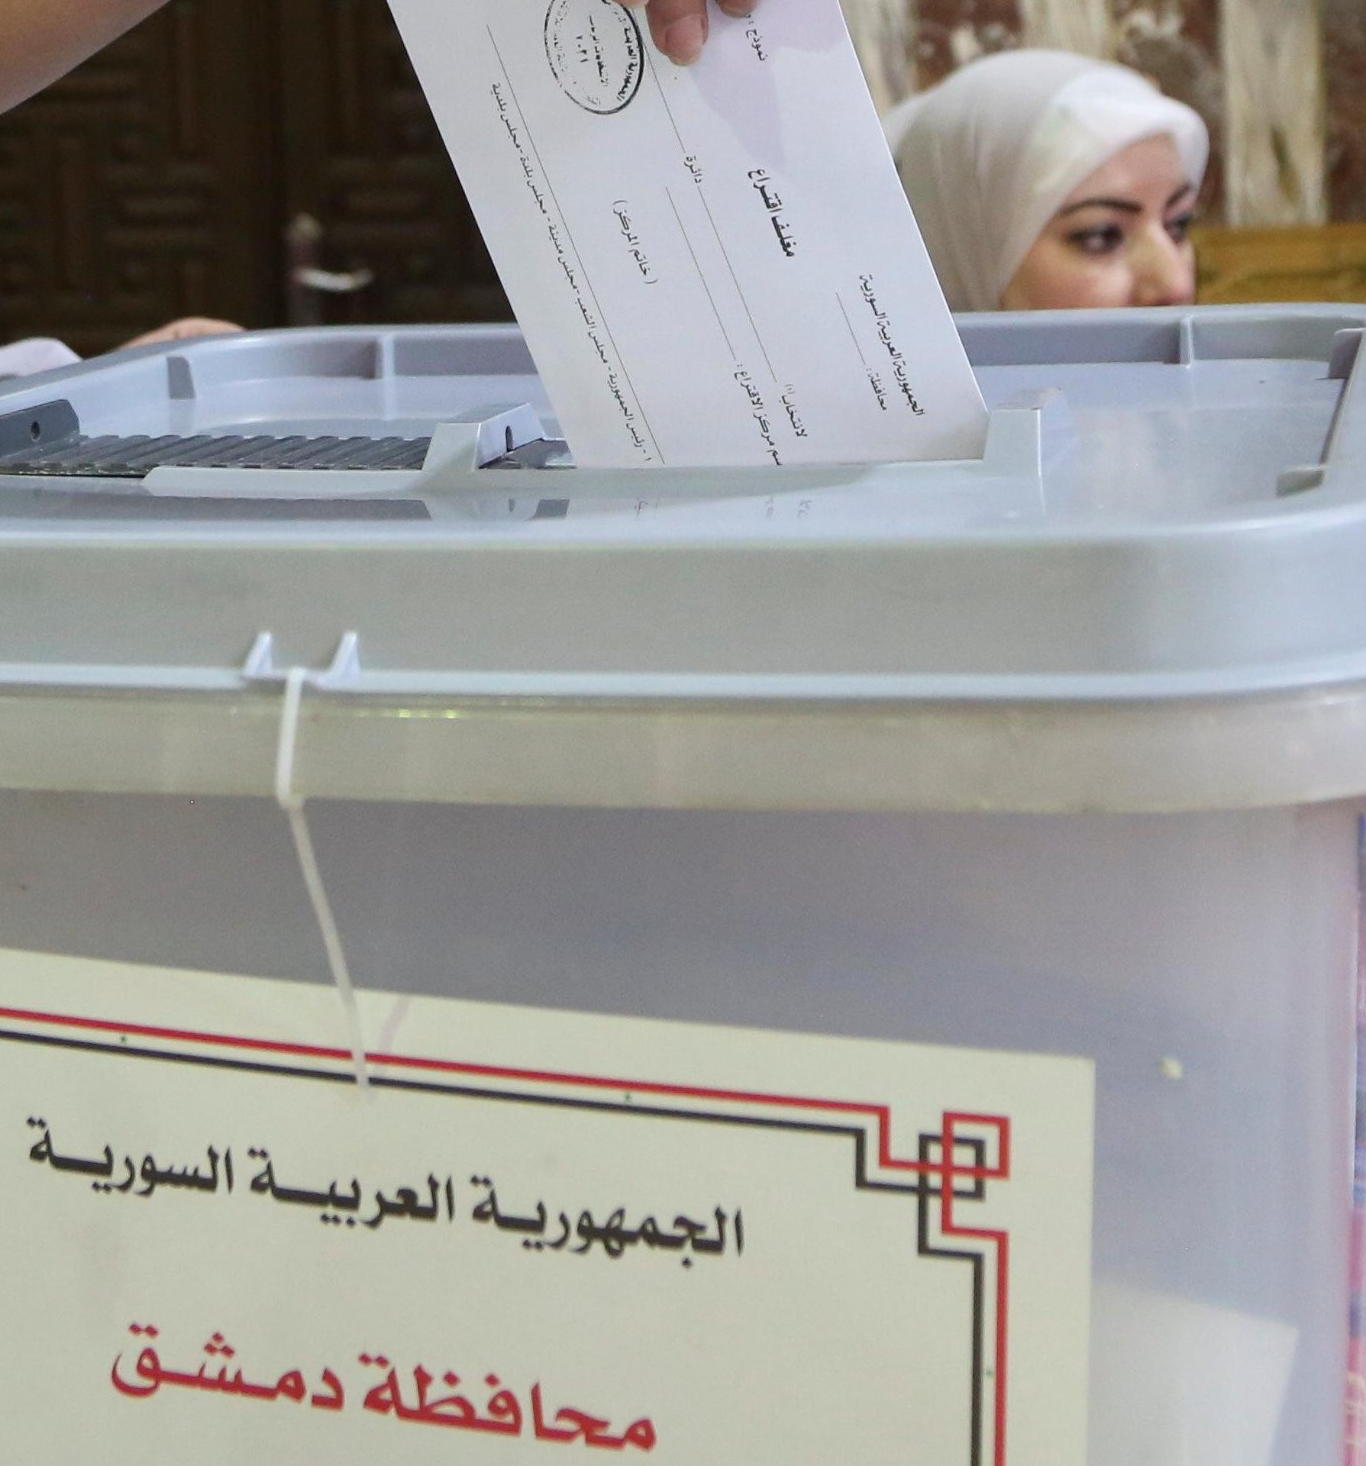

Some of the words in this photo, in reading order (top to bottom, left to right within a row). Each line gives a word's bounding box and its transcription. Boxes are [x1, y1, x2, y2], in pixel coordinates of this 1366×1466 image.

[527, 181, 547, 214] مجلس
[748, 169, 783, 213] اقتراع
[771, 215, 797, 257] مغلف
[859, 274, 887, 319] السورية
[588, 332, 608, 363] مجلس
[877, 317, 903, 359] العربية
[607, 374, 634, 420] الجمهورية
[734, 371, 763, 410] الاقتراع
[867, 373, 887, 410] محافظة
[893, 360, 925, 416] الجمهورية
[753, 413, 775, 446] مركز
[26, 1116, 235, 1195] السورية
[248, 1147, 456, 1229] العربية
[470, 1175, 745, 1269] الجمهورية
[109, 1322, 345, 1411] دمشق
[360, 1351, 657, 1452] محافظة
